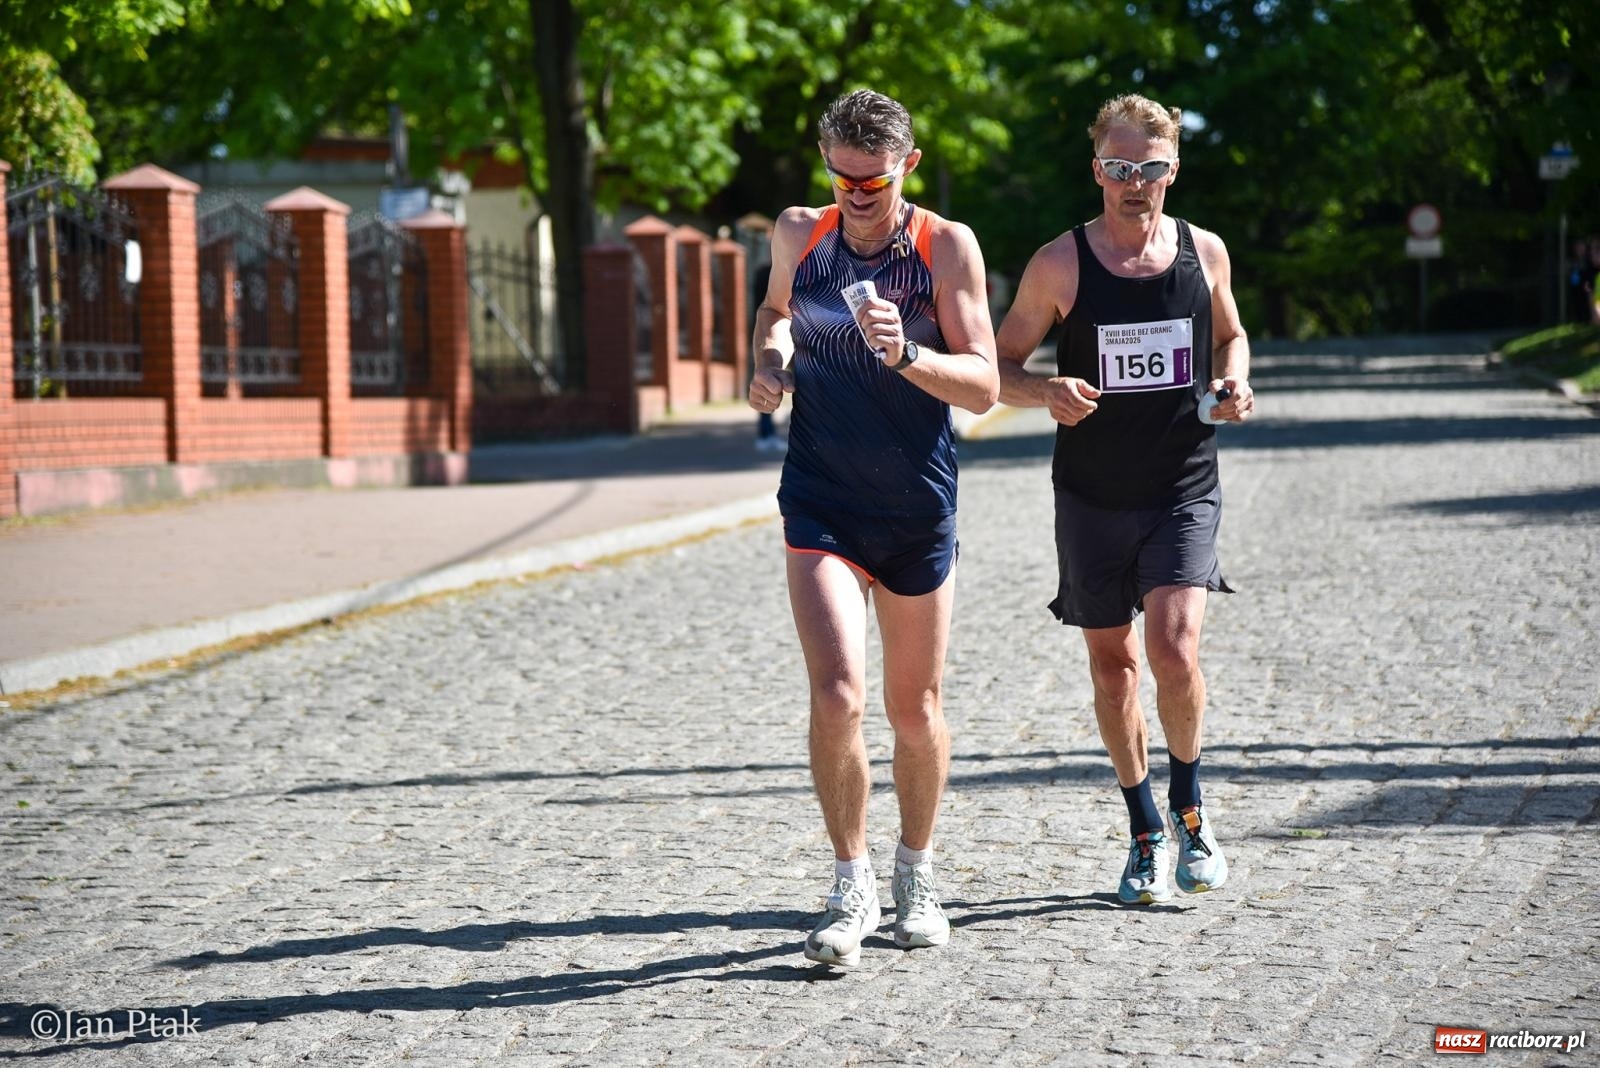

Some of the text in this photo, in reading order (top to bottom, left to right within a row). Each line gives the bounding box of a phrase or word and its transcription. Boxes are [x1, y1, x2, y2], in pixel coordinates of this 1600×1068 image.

[1138, 328, 1149, 336] BEZ
[1150, 326, 1173, 334] GRANIC
[1115, 352, 1165, 379] 156
